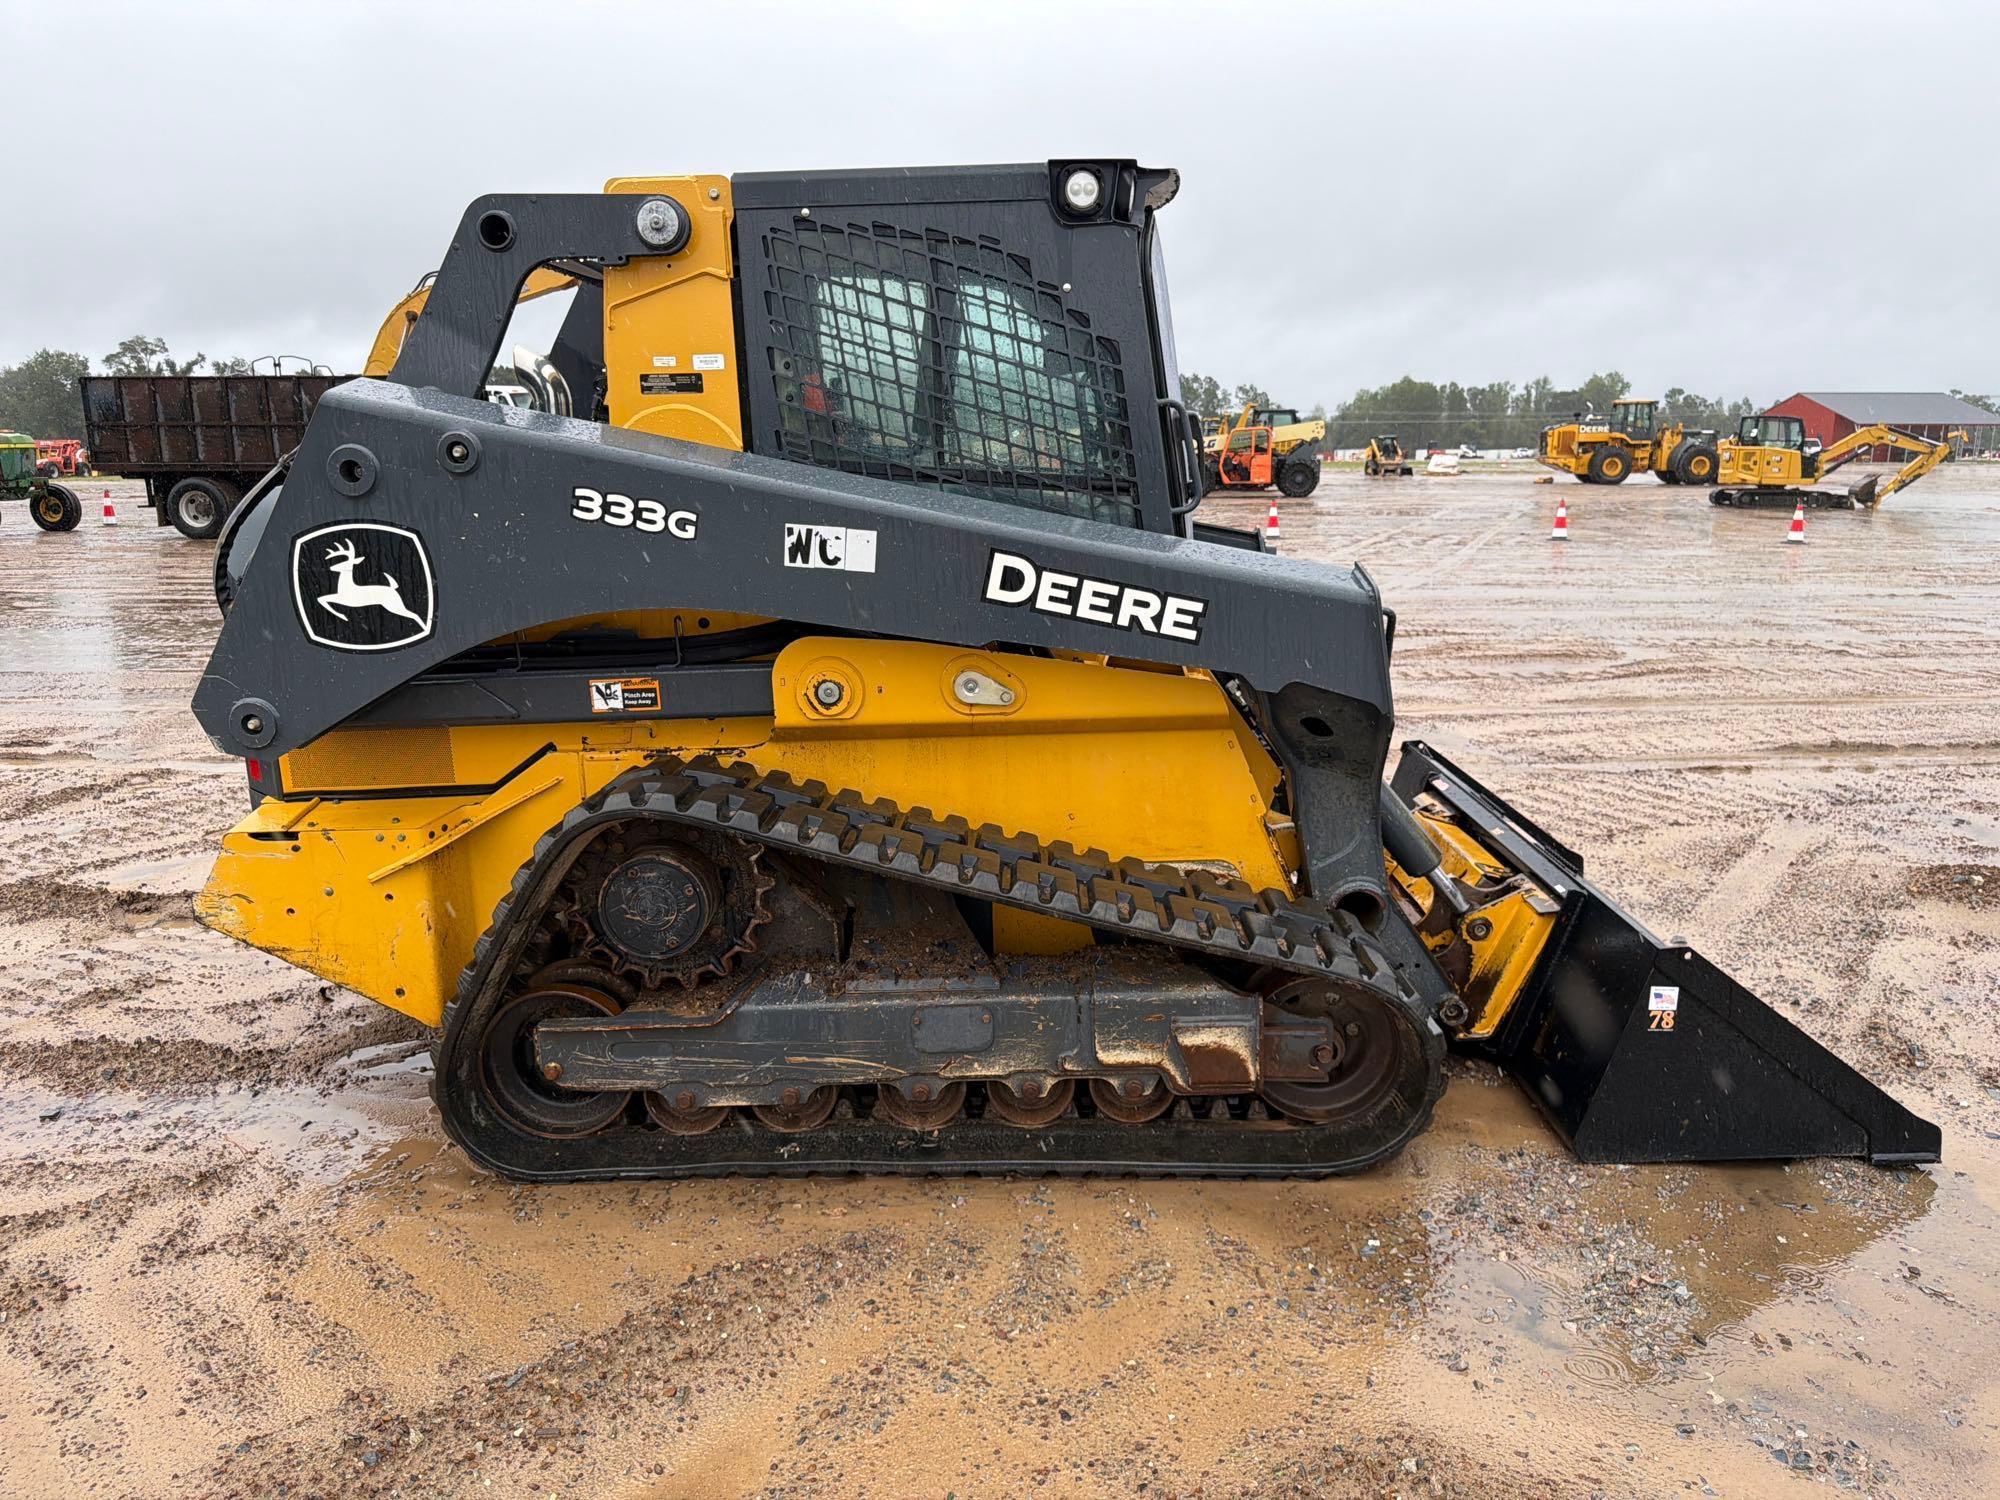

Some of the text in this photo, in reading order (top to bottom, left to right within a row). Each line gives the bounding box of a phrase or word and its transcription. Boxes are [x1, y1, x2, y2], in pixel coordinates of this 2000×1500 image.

[1579, 425, 1609, 433] DEERE
[571, 487, 697, 539] 333G
[985, 551, 1204, 641] DEERE
[1649, 1010, 1675, 1029] 78
